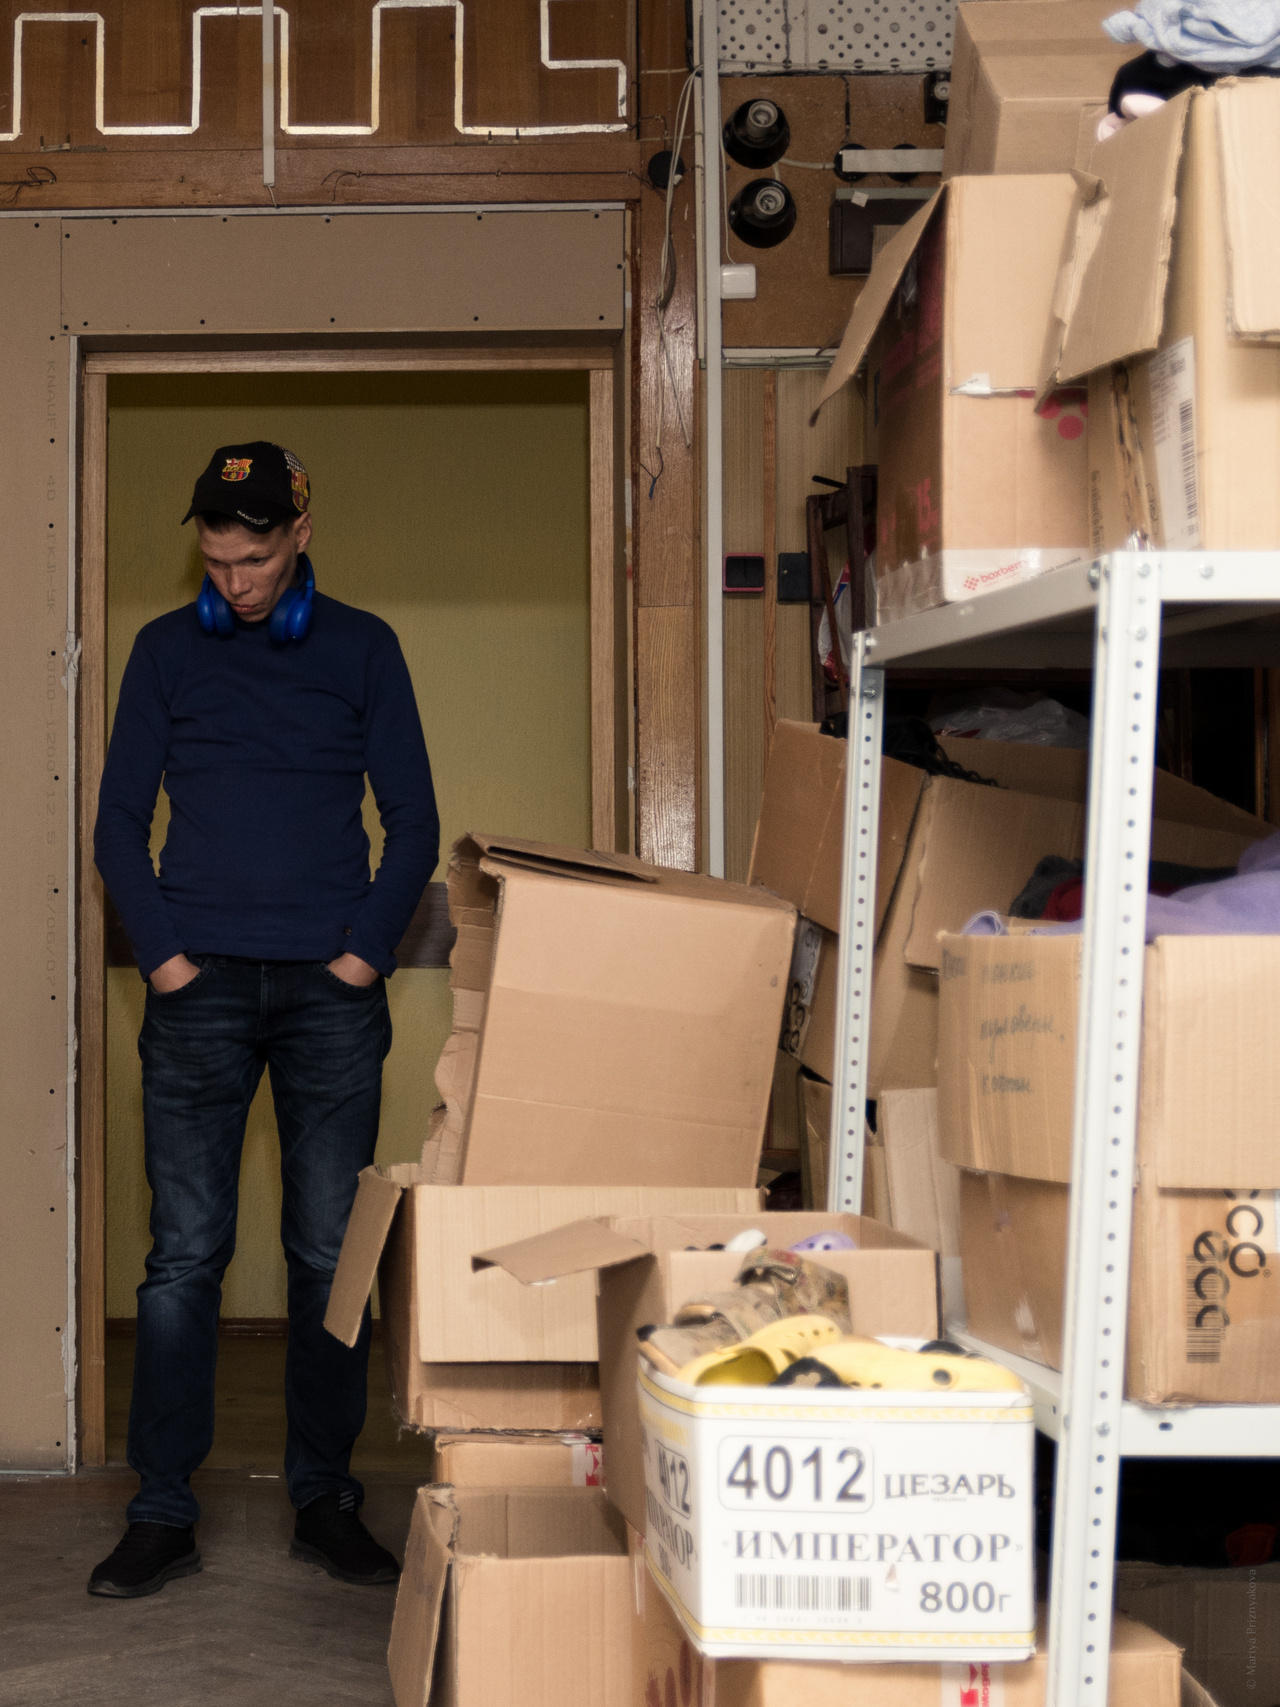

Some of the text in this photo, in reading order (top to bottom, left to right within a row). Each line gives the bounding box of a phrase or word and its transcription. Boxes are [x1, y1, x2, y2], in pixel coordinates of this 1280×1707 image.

[726, 1444, 867, 1503] 4012
[884, 1474, 1017, 1500] ЦЕЗАРЬ
[919, 1581, 1012, 1615] 800г
